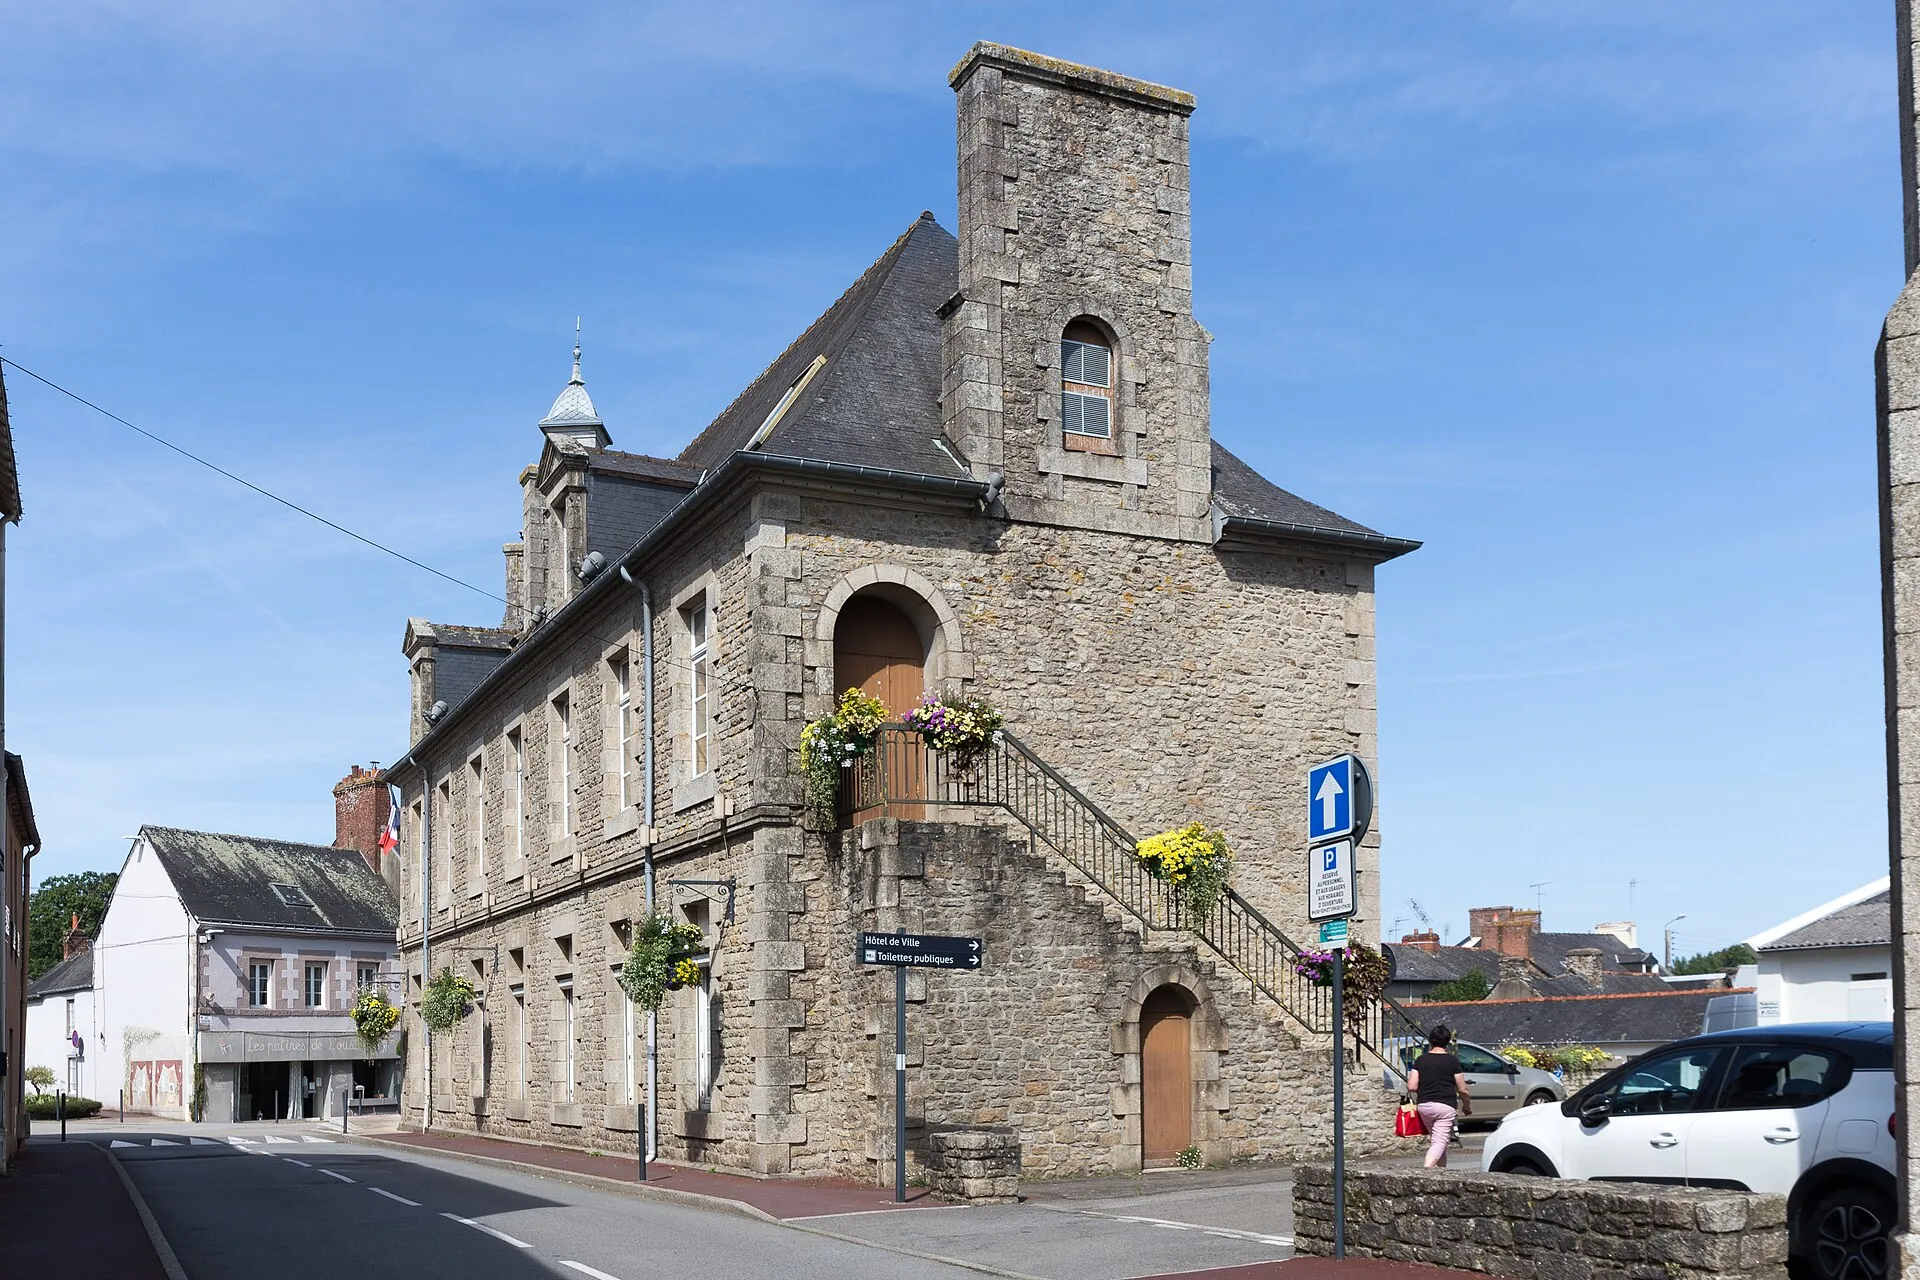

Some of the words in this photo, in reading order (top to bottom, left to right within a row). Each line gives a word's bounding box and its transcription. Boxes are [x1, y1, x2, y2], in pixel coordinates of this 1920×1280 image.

[1325, 850, 1334, 868] P
[865, 935, 888, 946] Hôtel
[889, 937, 900, 946] de
[901, 937, 920, 947] Ville
[877, 951, 912, 962] Toilettes
[914, 954, 954, 965] publiques
[247, 1037, 265, 1052] Les
[311, 1038, 323, 1051] de
